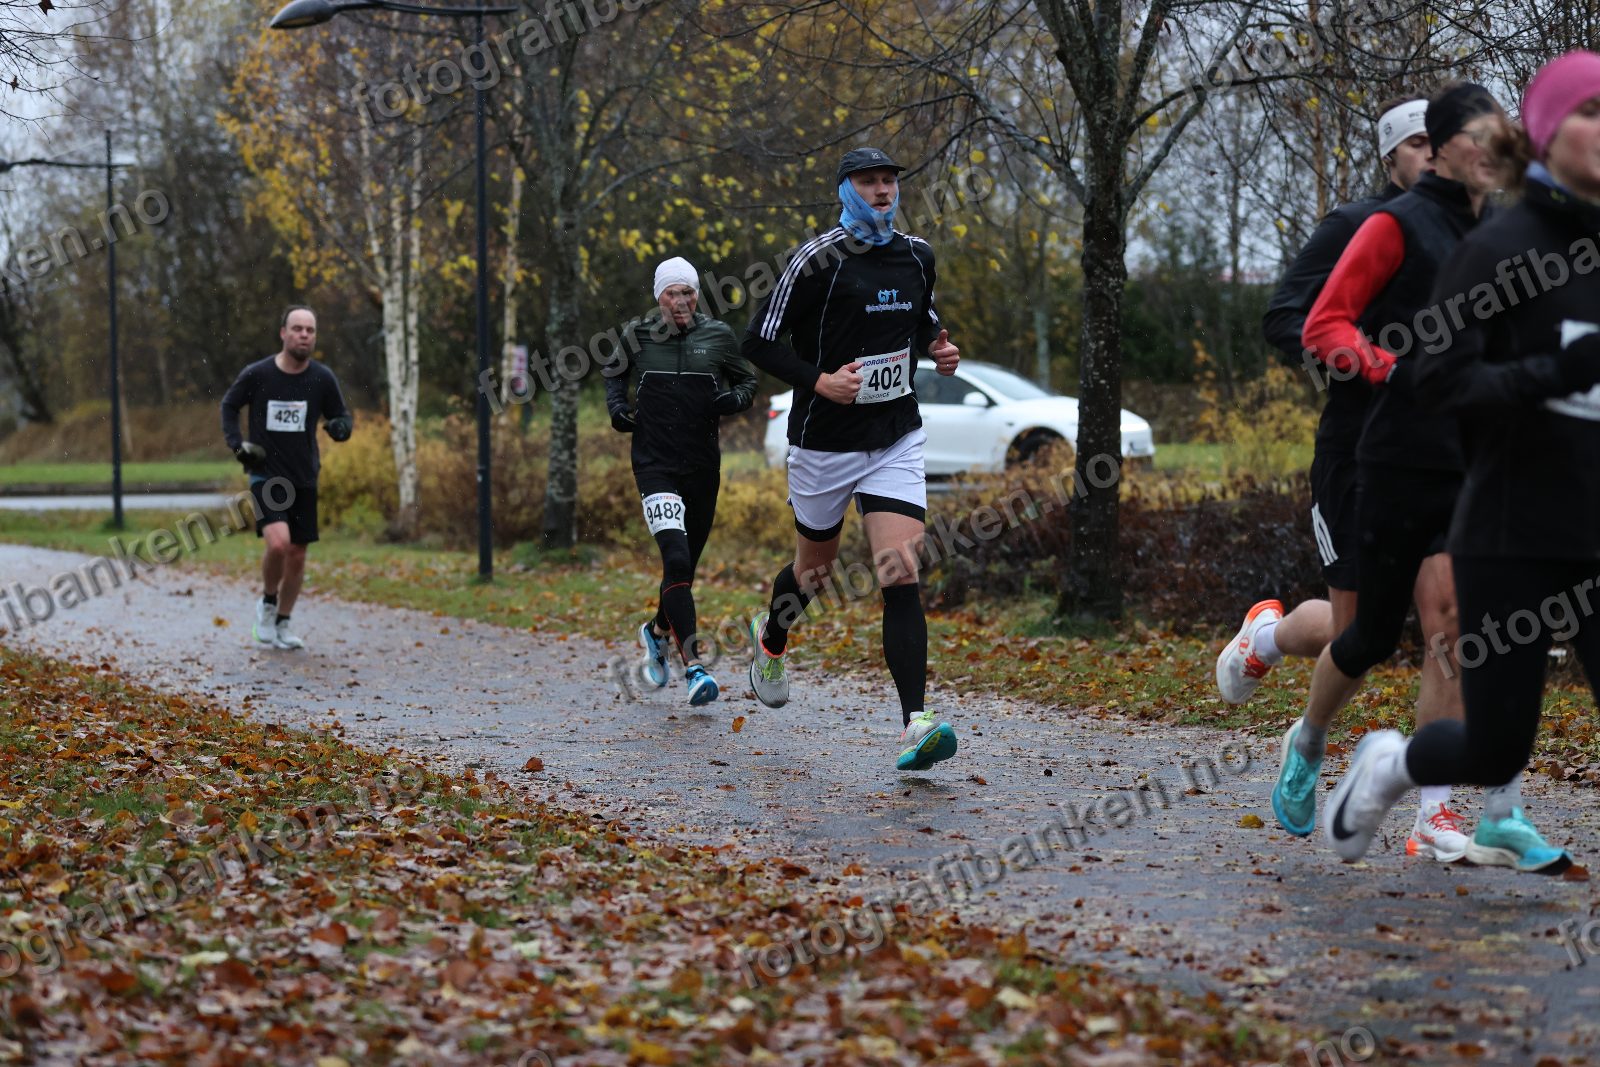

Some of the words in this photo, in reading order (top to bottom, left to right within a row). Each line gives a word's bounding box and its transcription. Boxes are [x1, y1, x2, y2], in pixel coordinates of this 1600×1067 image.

[868, 363, 902, 392] 402
[274, 409, 300, 424] 426
[646, 502, 682, 525] 9482
